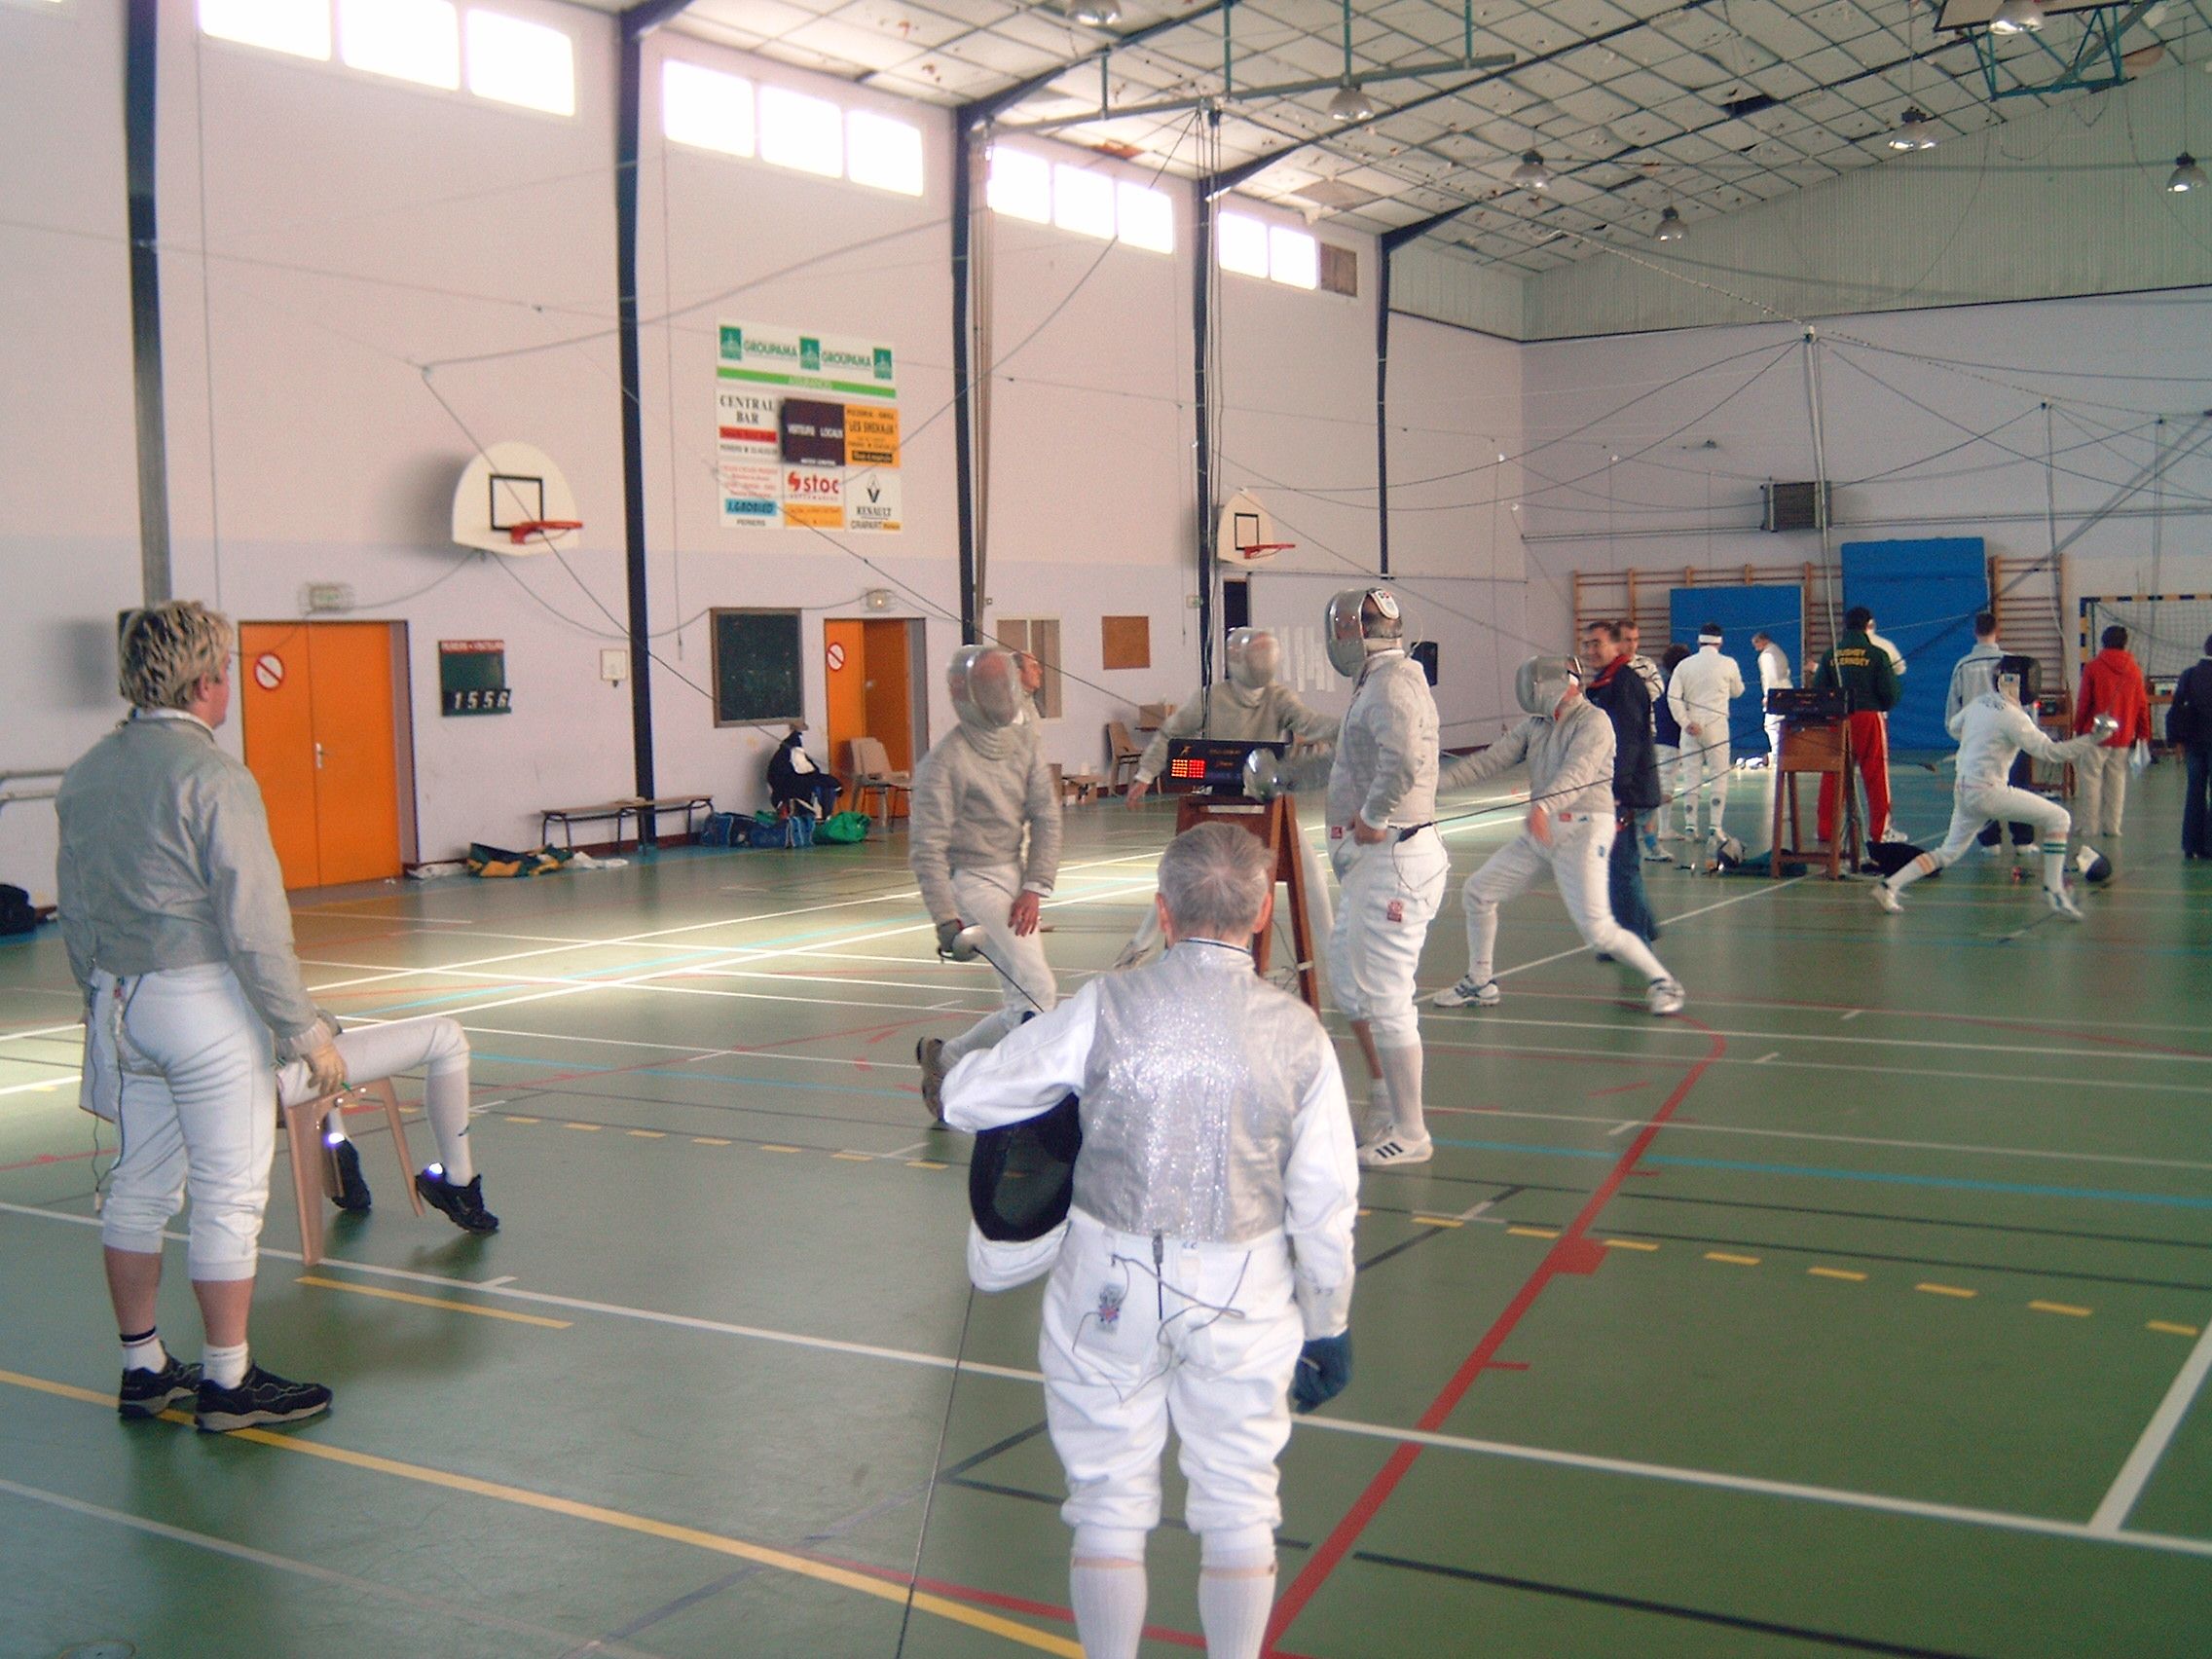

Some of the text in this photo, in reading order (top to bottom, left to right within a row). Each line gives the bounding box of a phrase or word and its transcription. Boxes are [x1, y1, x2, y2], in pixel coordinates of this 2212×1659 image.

[745, 342, 870, 367] GROUPAMA GROUPAMA
[719, 394, 773, 411] CENTRAL
[737, 411, 758, 424] BAR
[803, 473, 839, 495] stoc
[857, 505, 892, 518] RENAULT
